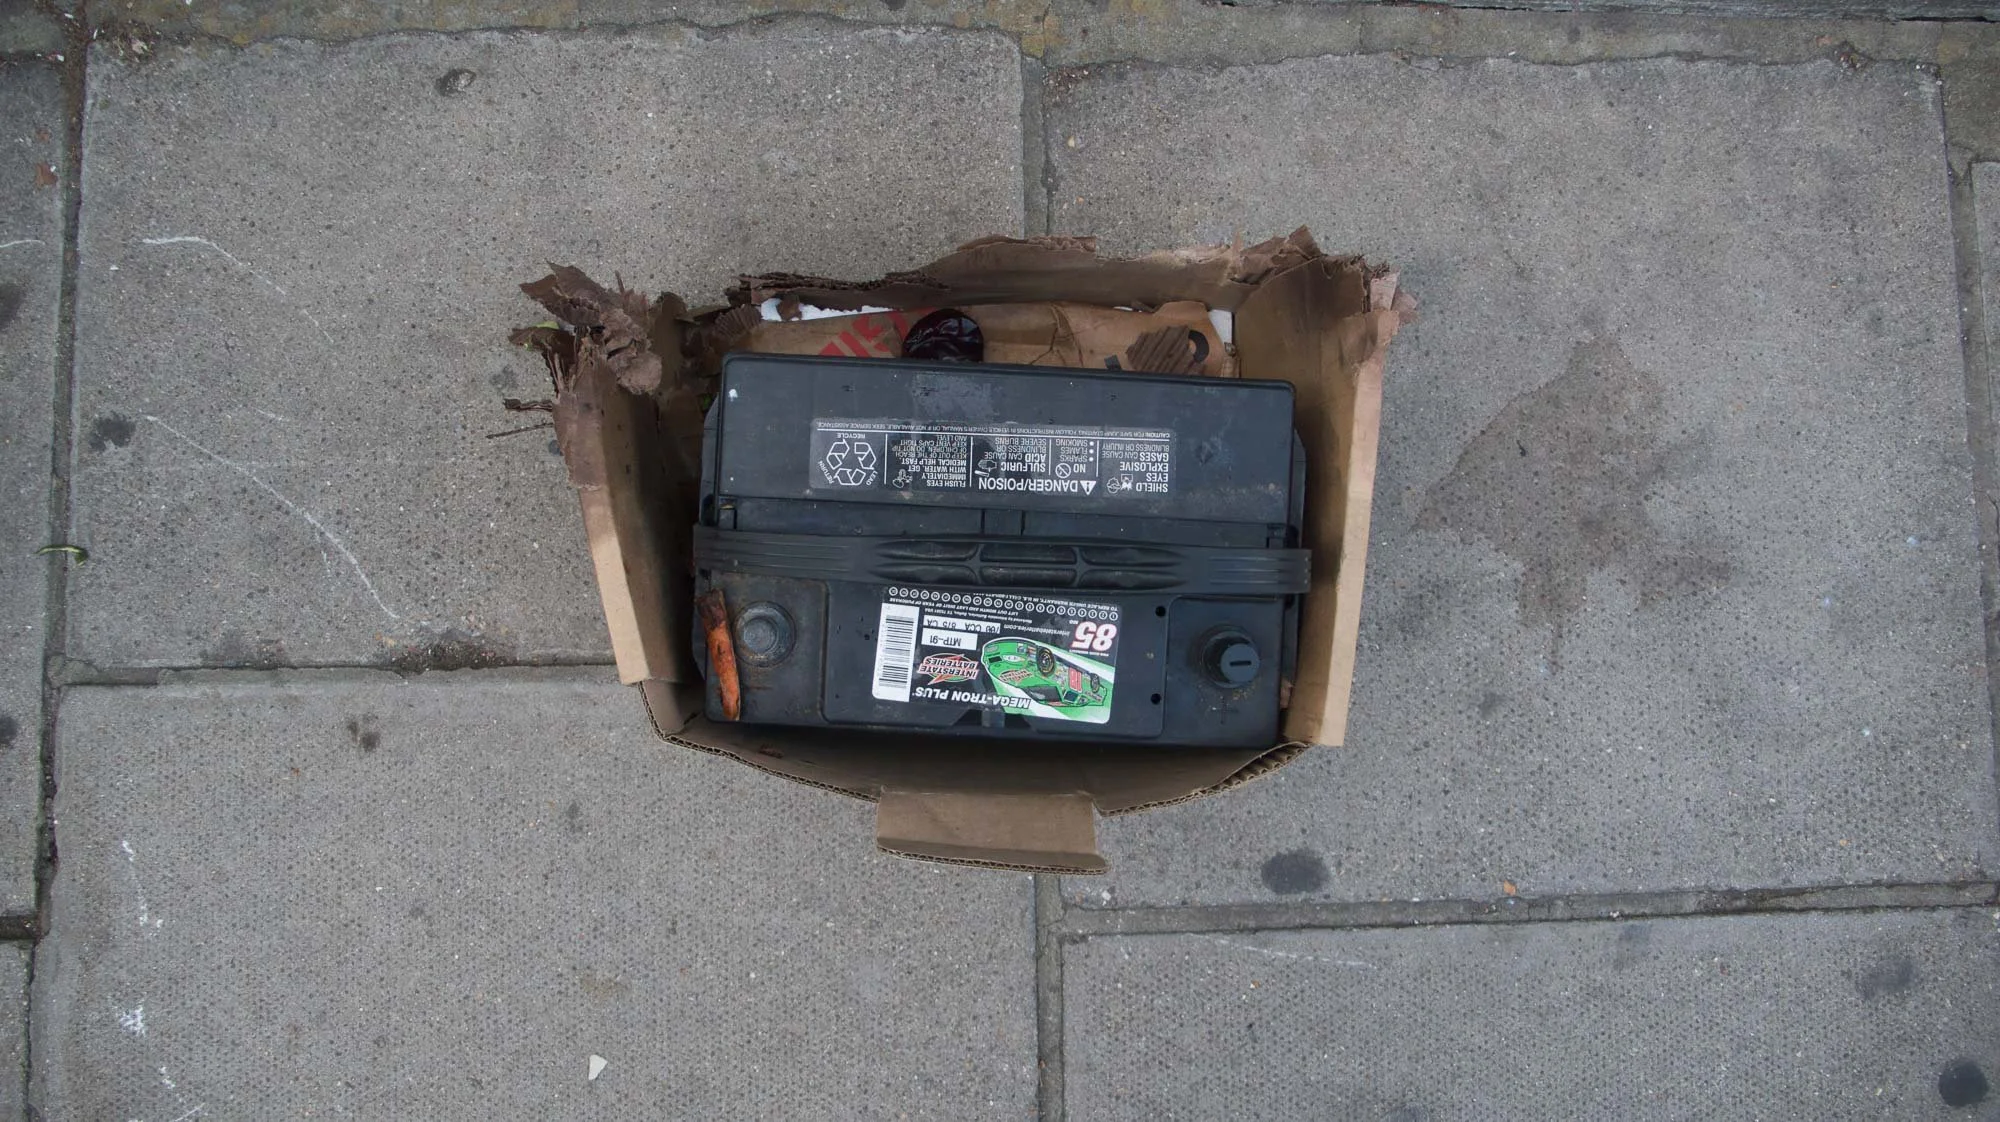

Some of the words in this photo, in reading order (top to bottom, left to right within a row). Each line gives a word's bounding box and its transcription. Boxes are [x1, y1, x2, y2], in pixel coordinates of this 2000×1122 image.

[1136, 444, 1169, 452] BLINDNESS
[1008, 452, 1022, 460] CAN
[1025, 453, 1046, 462] ACID
[1102, 450, 1123, 459] CAUSE
[1124, 451, 1138, 459] CAN
[1140, 452, 1169, 462] GASES
[1000, 462, 1046, 472] SULFURIC
[1074, 464, 1086, 472] NO
[1120, 461, 1169, 472] EXPLOSIVE
[818, 460, 834, 484] RETURN
[1146, 472, 1169, 482] EYES
[866, 471, 878, 486] LEAD
[979, 477, 1078, 492] DANGER/POISON
[1136, 483, 1168, 492] SHIELD
[927, 619, 938, 628] CA
[964, 623, 981, 633] CCA
[1003, 624, 1070, 636] interstatebatteries.com
[930, 635, 961, 647] MTP-91
[1071, 621, 1117, 652] 85
[924, 657, 976, 669] BATTERIES
[918, 665, 977, 679] INTERSTATE
[1068, 667, 1082, 693] 18
[915, 687, 949, 699] PLUS
[951, 690, 1030, 709] MEGA-TRON
